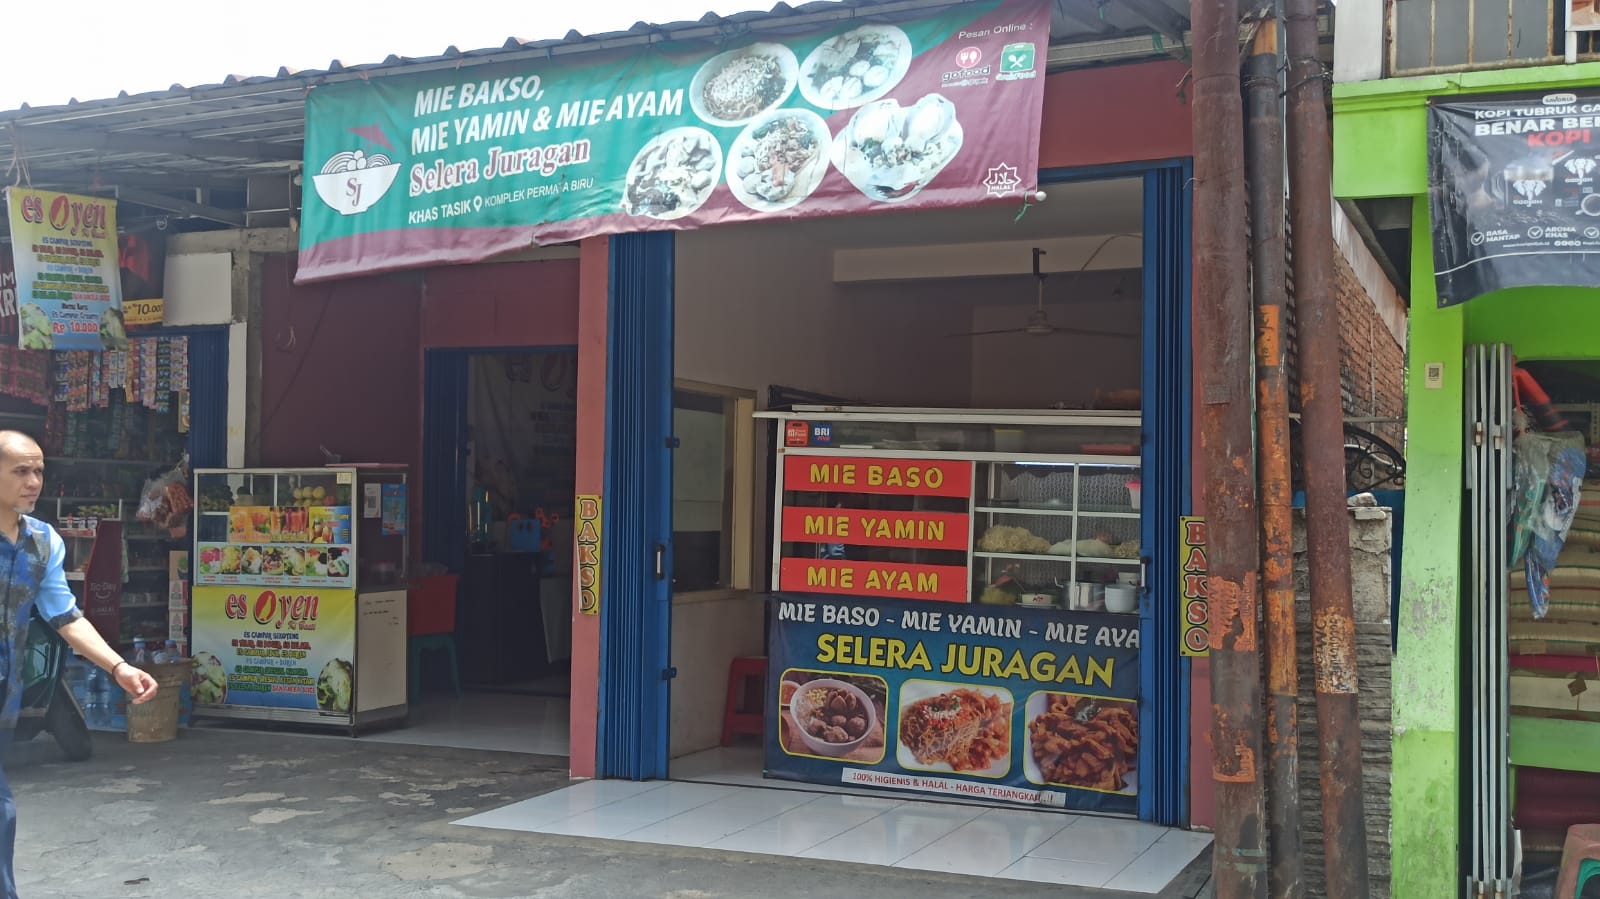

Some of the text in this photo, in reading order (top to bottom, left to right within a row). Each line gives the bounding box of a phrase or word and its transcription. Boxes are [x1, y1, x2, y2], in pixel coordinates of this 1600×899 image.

[959, 29, 990, 40] Pesan
[993, 23, 1027, 34] Online
[942, 65, 991, 82] gofood
[413, 75, 545, 118] MIE BAKSO,
[411, 89, 684, 156] MIE YAMIN & MIE AYAM
[1475, 109, 1511, 120] KOPI
[1514, 106, 1577, 117] TUBRUK
[1475, 118, 1556, 137] BENAR
[1527, 129, 1591, 148] KOPI
[409, 138, 591, 197] Selera Juragan
[408, 177, 594, 224] KHAS TASIK KOMPLEK PERMAA BIRU
[1486, 228, 1509, 237] RASA
[53, 322, 65, 333] Rp
[814, 427, 830, 437] BRI
[810, 463, 944, 489] MIE BASO
[804, 515, 945, 542] MIE YAMIN
[807, 566, 939, 594] MIE AYAM
[225, 589, 320, 629] es Oyen
[778, 601, 816, 623] MIE
[822, 604, 880, 627] BASO
[901, 610, 942, 632] MIE
[948, 613, 1022, 639] YAMIN
[1045, 622, 1089, 645] MIE
[816, 632, 1115, 689] SELERA JURAGAN
[852, 771, 872, 782] 100%
[874, 773, 911, 787] HIGIENIS
[912, 779, 919, 787] &
[921, 779, 949, 790] HALAL
[955, 784, 986, 795] HARGA
